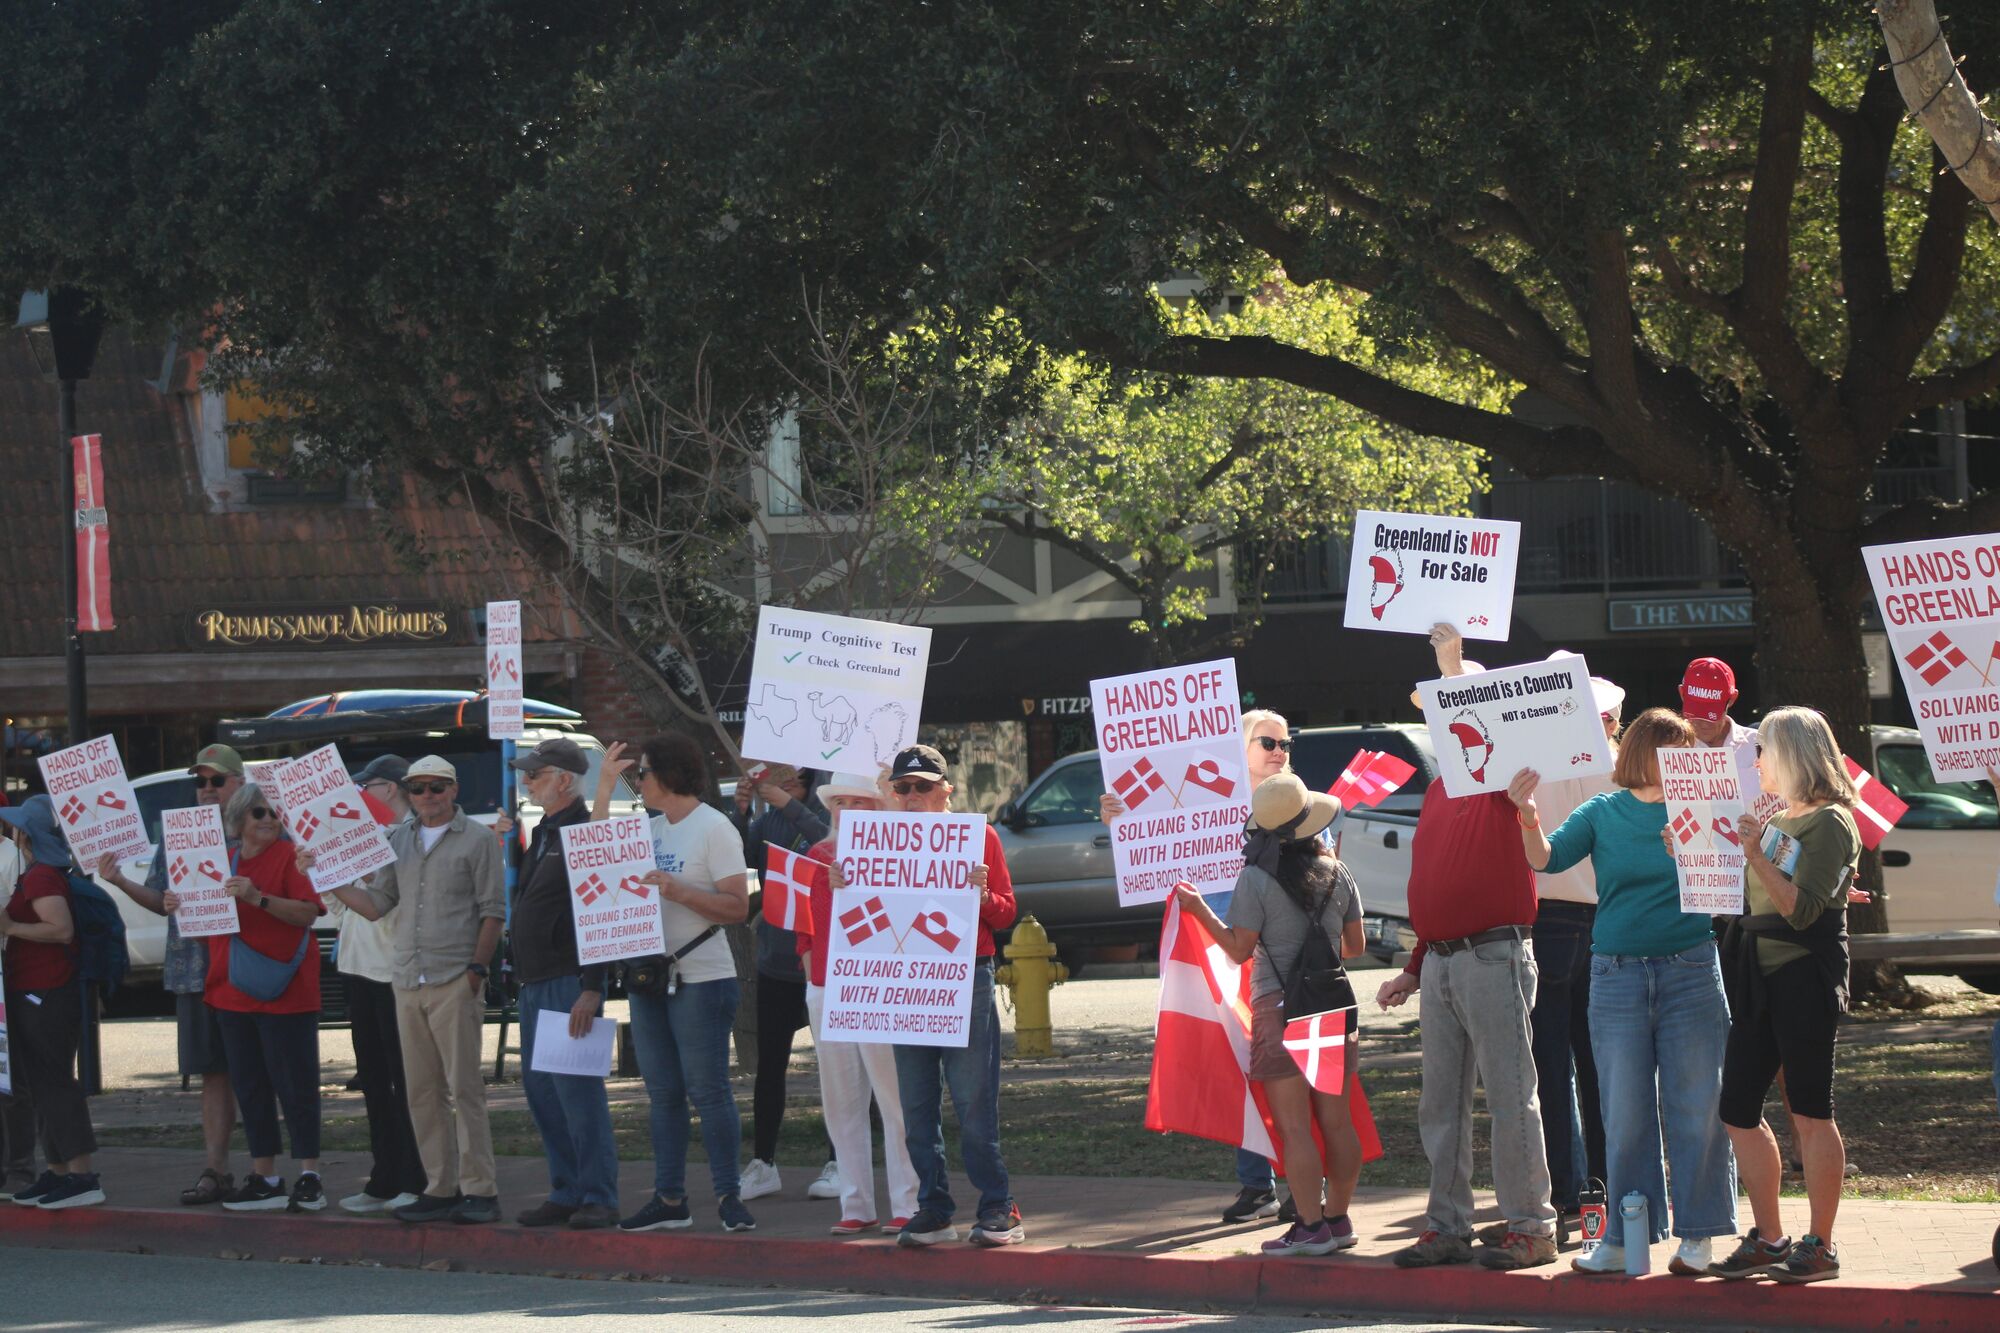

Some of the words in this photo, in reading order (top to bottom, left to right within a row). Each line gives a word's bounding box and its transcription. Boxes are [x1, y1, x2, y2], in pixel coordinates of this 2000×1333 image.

[1375, 524, 1452, 553] Greenland
[1454, 531, 1468, 554] is
[1471, 532, 1500, 557] NOT
[1421, 559, 1447, 579] For
[1451, 561, 1488, 583] Sale
[1882, 549, 1971, 587] HANDS
[1631, 604, 1679, 625] THE
[769, 623, 812, 642] Trump
[822, 630, 882, 650] Cognitive
[892, 641, 918, 656] Test
[808, 655, 840, 668] Check
[847, 659, 900, 677] Greenland
[1105, 677, 1177, 717] HANDS
[1183, 670, 1222, 704] OFF
[1437, 681, 1500, 709] Greenland
[1501, 682, 1514, 698] is
[1514, 680, 1523, 695] a
[1523, 671, 1573, 695] Country
[1688, 685, 1722, 699] DANMARK
[1502, 711, 1518, 723] NOT
[1521, 710, 1526, 719] a
[1527, 704, 1559, 718] Casino
[1919, 693, 1999, 720] SOLVANG
[1103, 704, 1237, 753] GREENLAND!
[1937, 722, 1982, 744] WITH
[46, 748, 86, 775] HANDS
[87, 740, 109, 761] OFF
[281, 762, 313, 788] HANDS
[313, 749, 333, 772] OFF
[1663, 752, 1701, 774] HANDS
[1703, 752, 1727, 774] OFF
[1935, 750, 1974, 771] SHARED
[49, 758, 122, 795] GREENLAND!
[284, 768, 350, 809] GREENLAND!
[1664, 778, 1739, 800] GREENLAND!
[69, 825, 102, 844] SOLVANG
[105, 813, 138, 832] STANDS
[166, 811, 193, 829] HANDS
[195, 809, 214, 827] OFF
[344, 821, 376, 842] STANDS
[1118, 815, 1186, 842] SOLVANG
[1192, 805, 1249, 831] STANDS
[79, 842, 97, 856] WITH
[100, 829, 138, 852] DENMARK
[166, 829, 223, 851] GREENLAND!
[569, 824, 613, 847] HANDS
[617, 819, 641, 840] OFF
[852, 821, 923, 852] HANDS
[930, 823, 971, 853] OFF
[316, 855, 338, 872] WITH
[340, 836, 380, 862] DENMARK
[568, 840, 651, 870] GREENLAND!
[1129, 844, 1166, 866] WITH
[1172, 831, 1243, 861] DENMARK
[1678, 854, 1715, 867] SOLVANG
[1717, 854, 1744, 867] STANDS
[1123, 870, 1155, 894] SHARED
[1187, 861, 1218, 886] SHARED
[1685, 873, 1705, 887] WITH
[1708, 873, 1740, 888] DENMARK
[196, 904, 229, 916] DENMARK
[579, 910, 620, 927] SOLVANG
[623, 904, 657, 920] STANDS
[585, 929, 608, 942] WITH
[611, 921, 655, 938] DENMARK
[833, 959, 903, 978] SOLVANG
[908, 962, 968, 981] STANDS
[840, 985, 879, 1004] WITH
[883, 987, 959, 1007] DENMARK
[829, 1011, 862, 1030] SHARED
[863, 1013, 891, 1035] ROOTS,
[893, 1014, 927, 1033] SHARED
[927, 1015, 964, 1035] RESPECT
